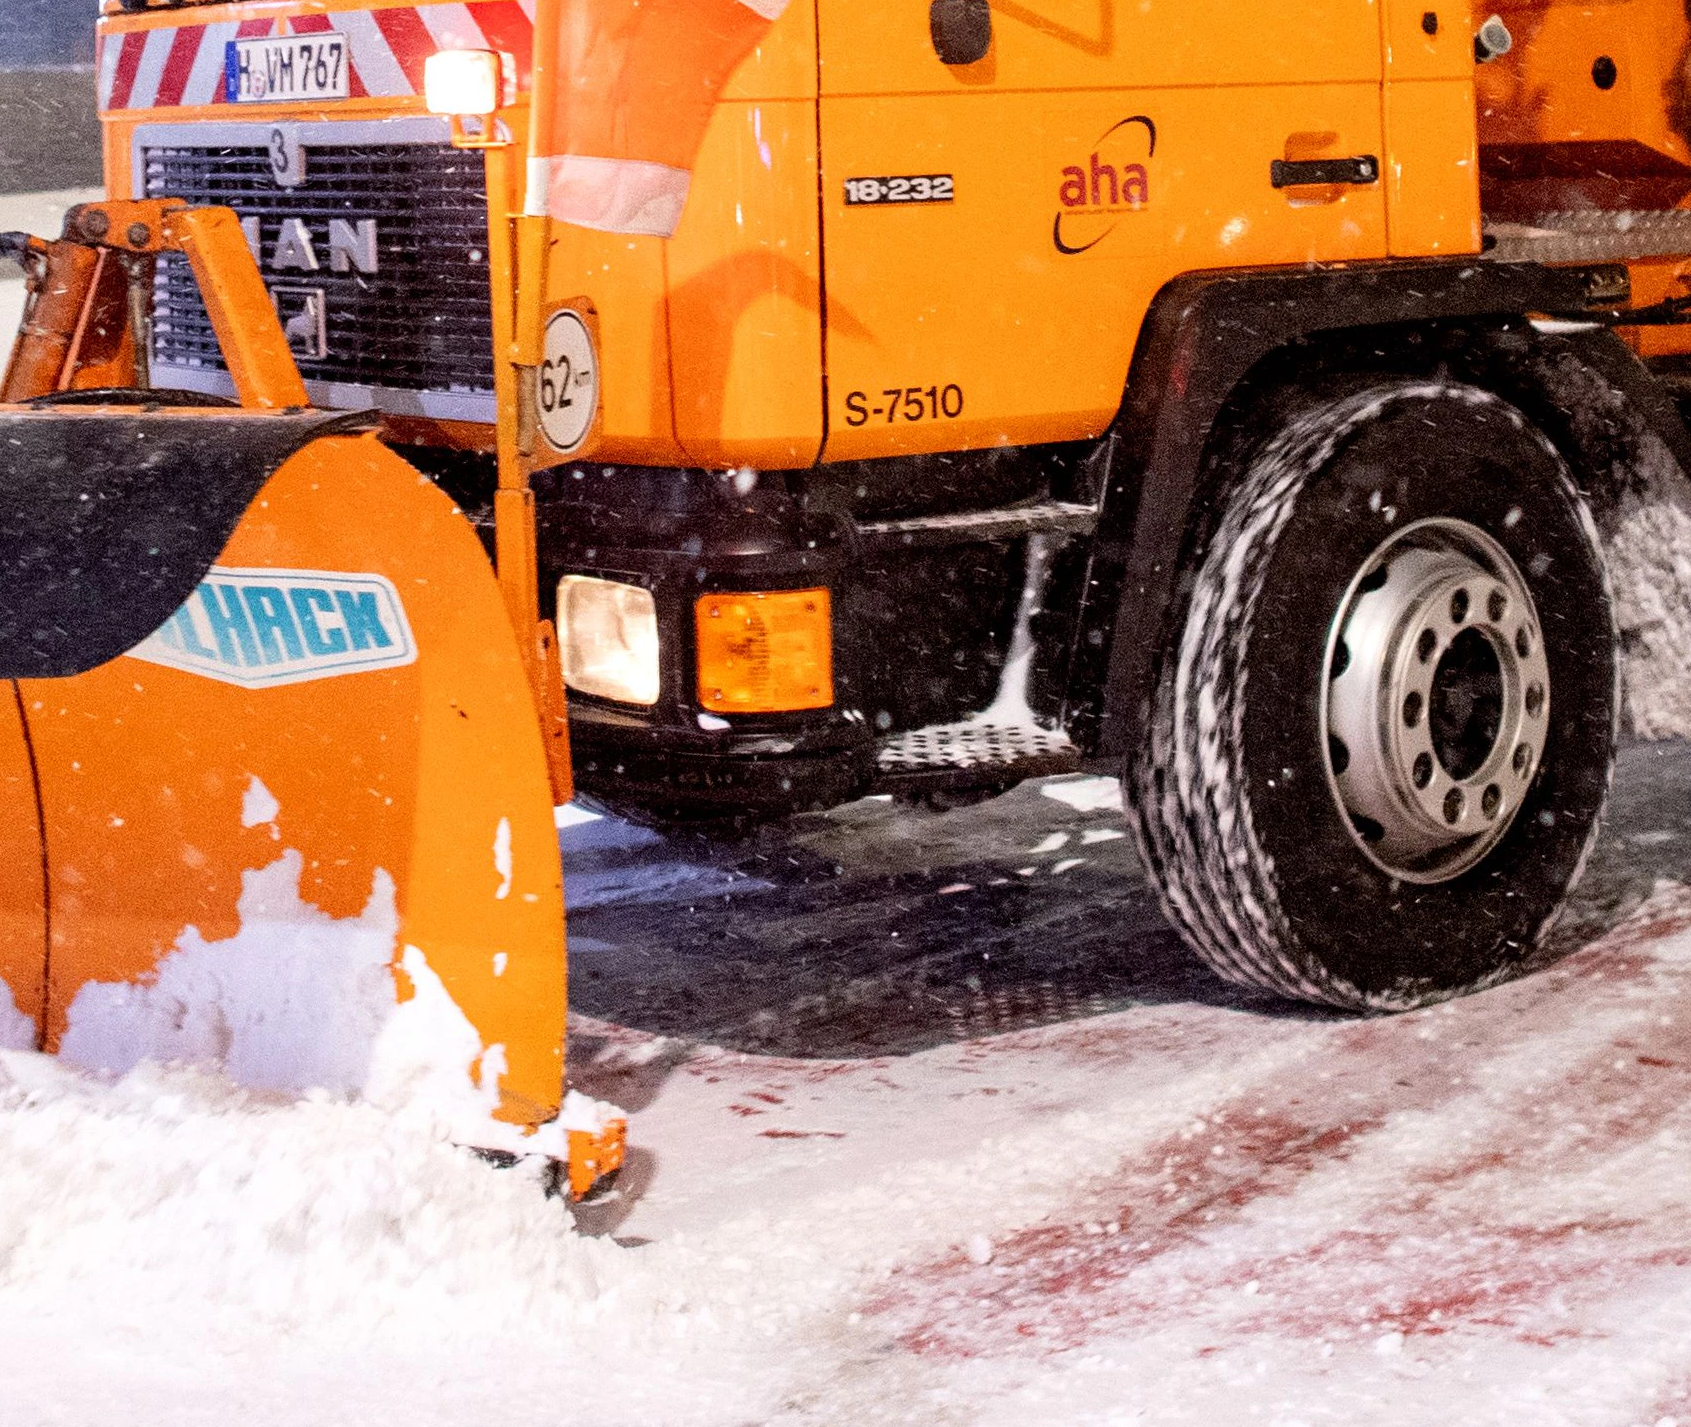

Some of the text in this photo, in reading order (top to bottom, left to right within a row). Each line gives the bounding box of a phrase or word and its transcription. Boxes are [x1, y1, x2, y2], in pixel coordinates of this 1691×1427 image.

[238, 48, 251, 95] H
[299, 42, 342, 91] 767
[271, 128, 289, 174] 3
[1059, 152, 1149, 207] aha
[241, 215, 379, 273] AN
[541, 355, 573, 413] 62
[846, 383, 964, 427] S-7510
[159, 581, 394, 668] LHACK
